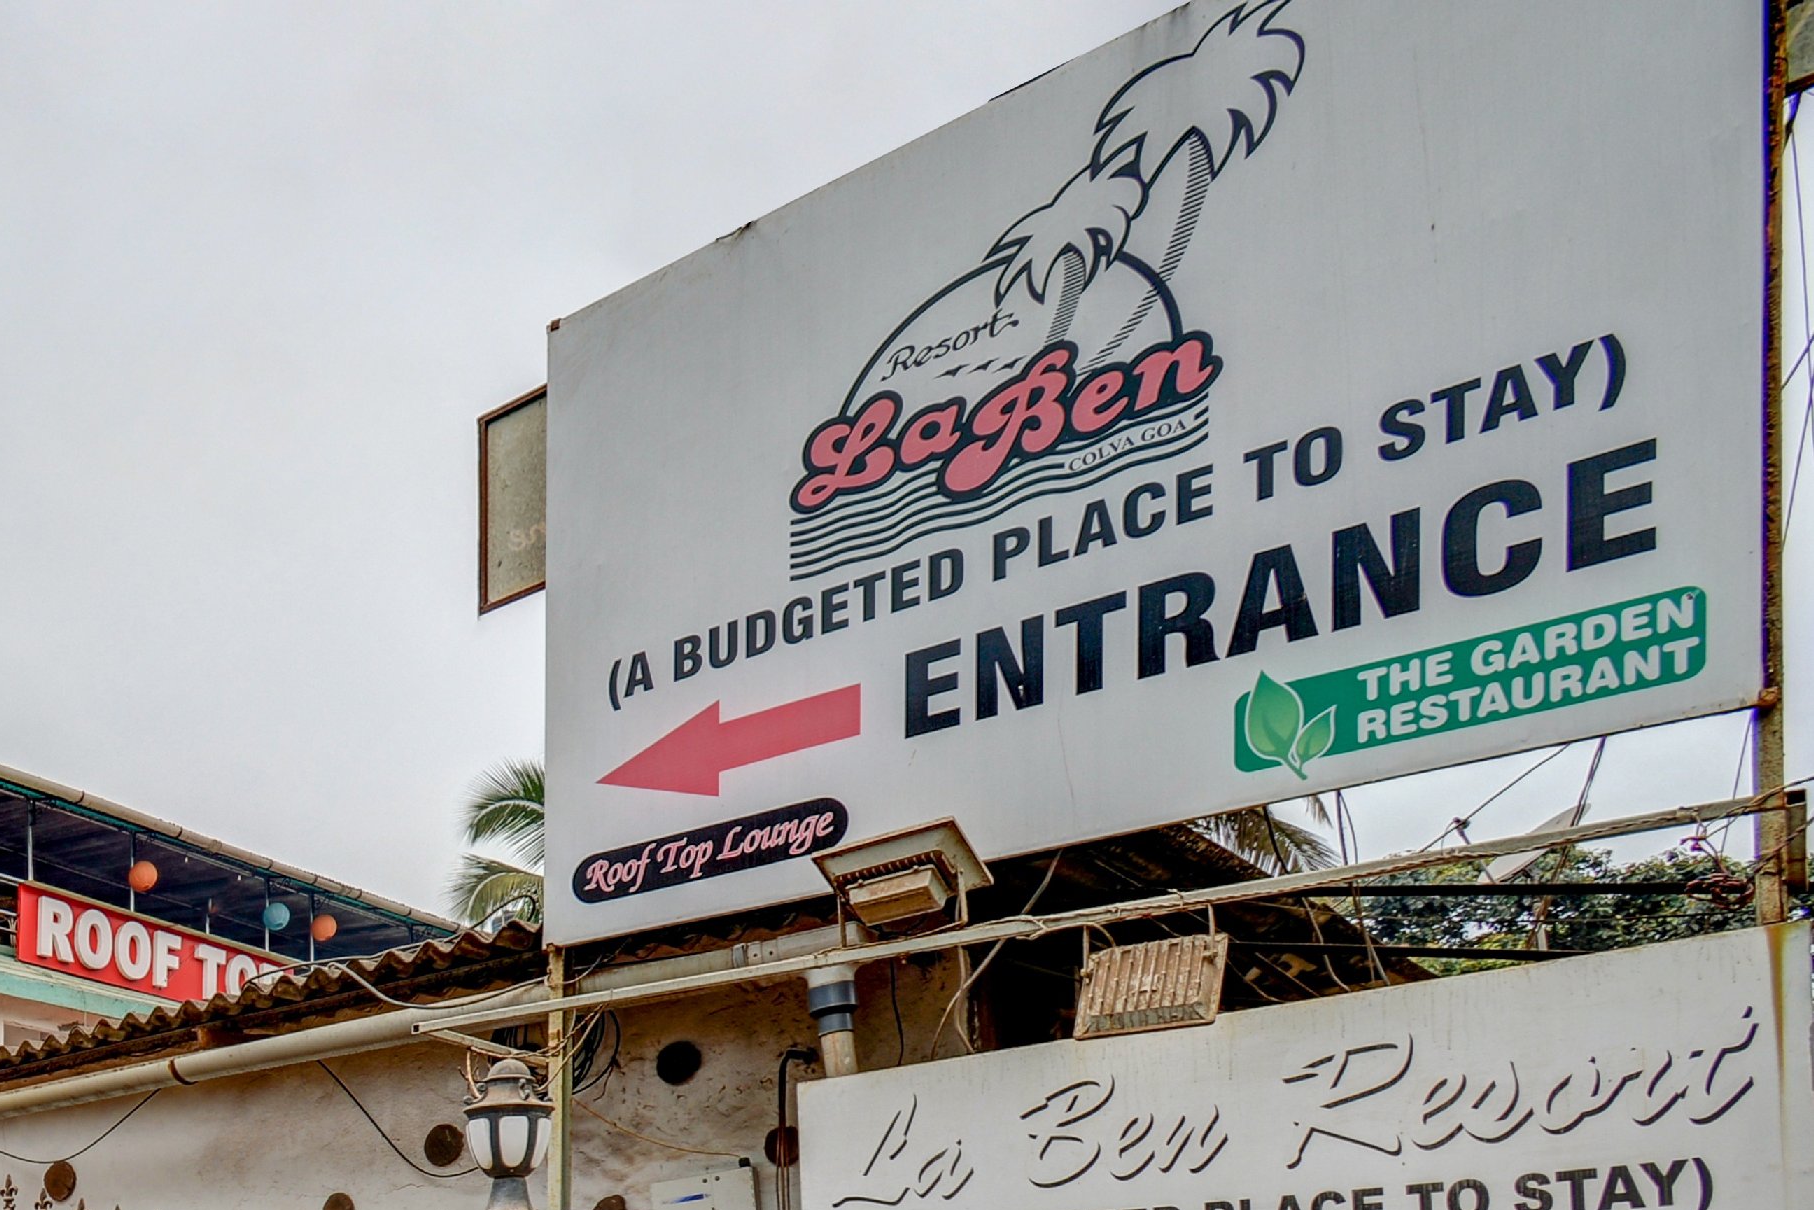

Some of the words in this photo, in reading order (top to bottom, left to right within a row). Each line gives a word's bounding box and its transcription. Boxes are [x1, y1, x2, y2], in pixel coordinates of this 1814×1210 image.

[881, 308, 1019, 381] Resort
[1067, 434, 1136, 472] COLVA
[1140, 417, 1187, 443] GOA
[673, 548, 963, 682] BUDGETED
[992, 464, 1214, 582] PLACE
[1243, 425, 1343, 502] TO
[1378, 333, 1627, 463] STAY)
[904, 438, 1657, 740] ENTRANCE
[1358, 651, 1454, 700] THE
[1471, 593, 1696, 677] GARDEN
[1358, 637, 1700, 743] RESTAURANT
[584, 843, 656, 892] Roof
[656, 838, 713, 879] Top
[716, 811, 834, 855] Lounge
[36, 895, 182, 988] ROOF
[832, 1094, 974, 1208] La
[1020, 1074, 1228, 1188] Ben
[1282, 1006, 1759, 1168] Resort
